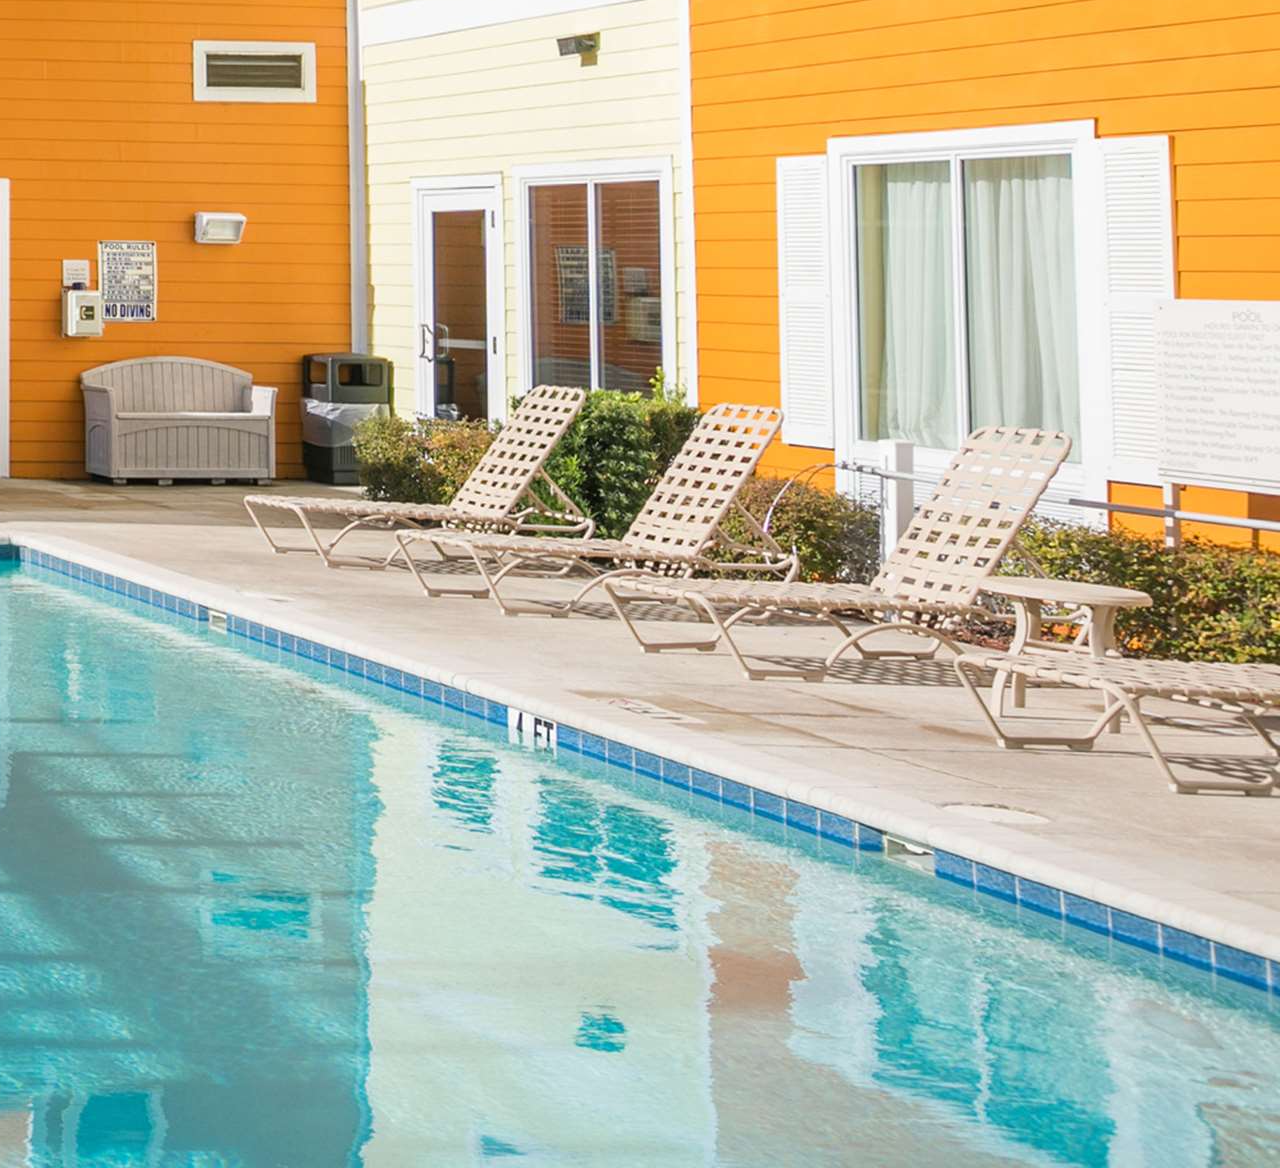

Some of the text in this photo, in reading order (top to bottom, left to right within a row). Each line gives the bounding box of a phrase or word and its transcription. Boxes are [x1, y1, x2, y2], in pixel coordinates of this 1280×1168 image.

[104, 303, 151, 318] NO DIVING
[533, 716, 554, 743] FT
